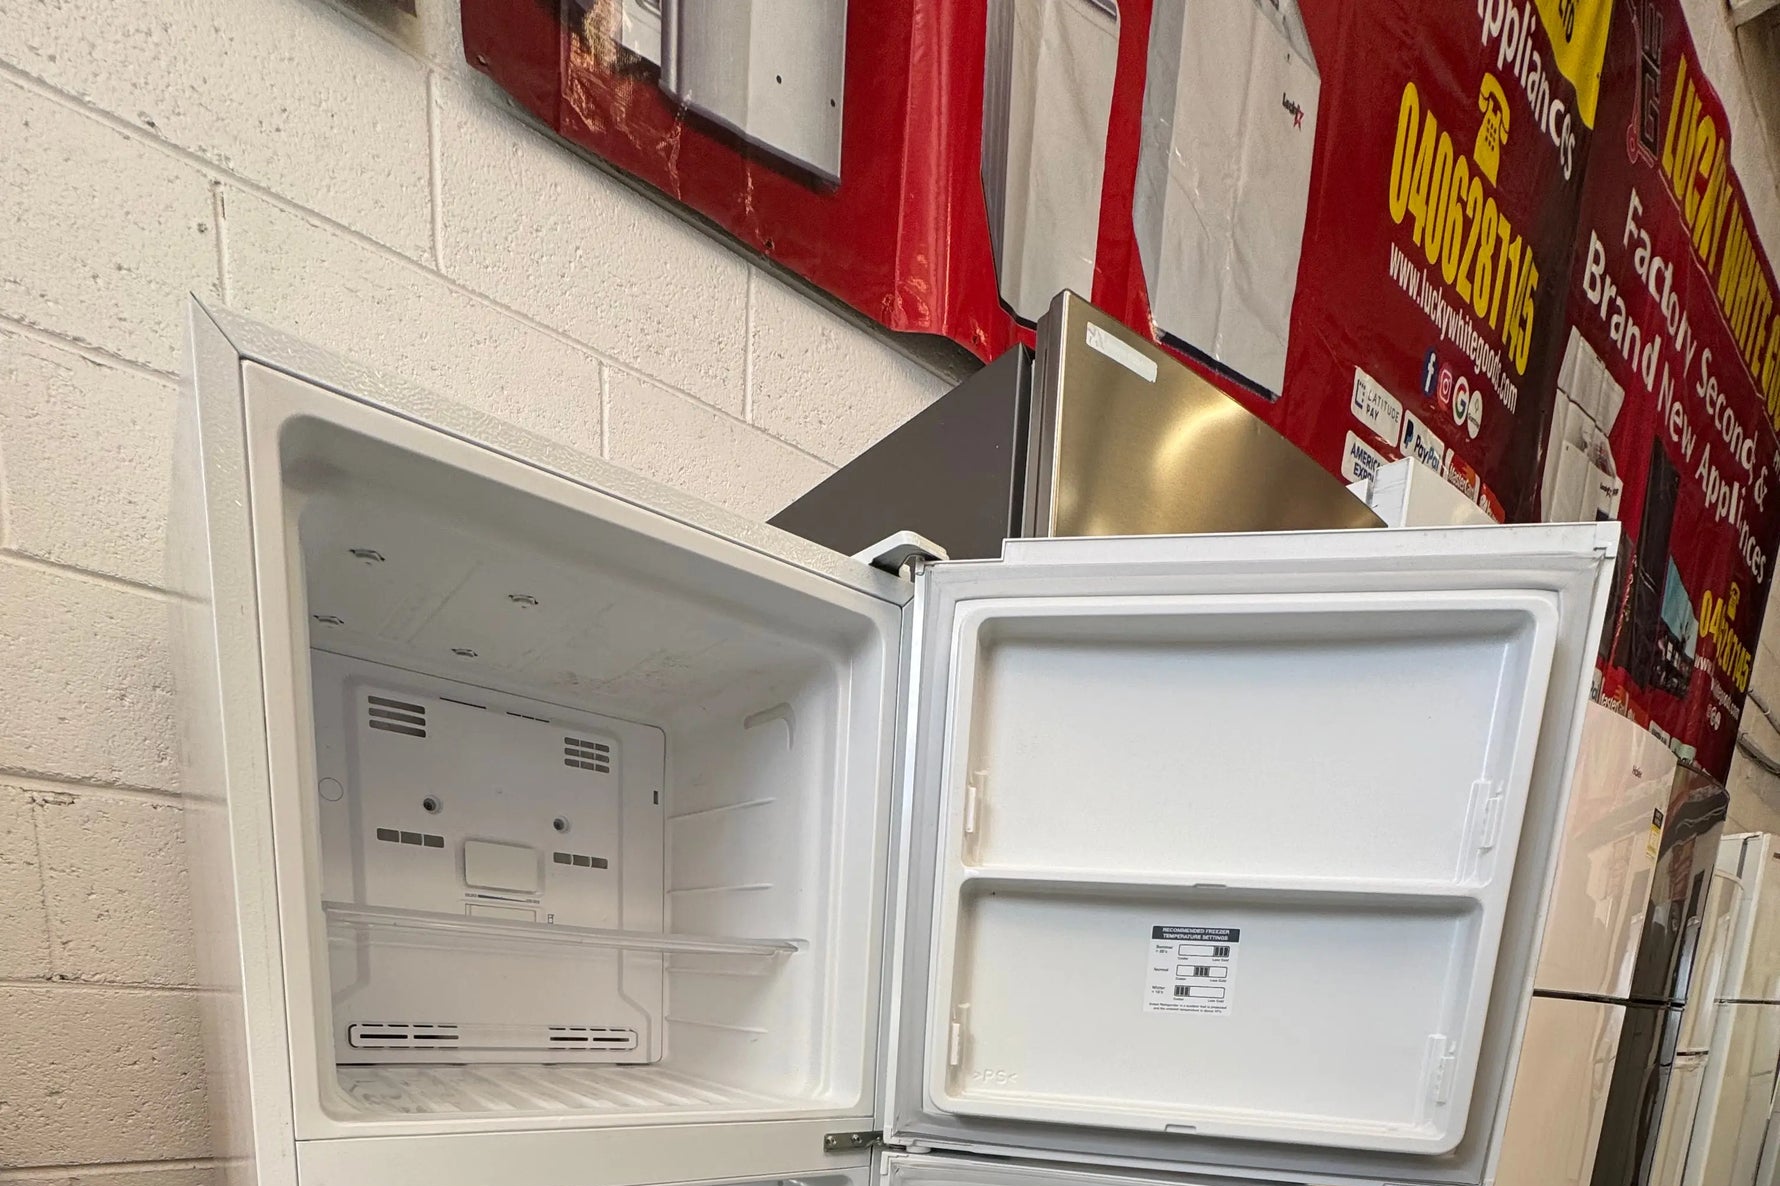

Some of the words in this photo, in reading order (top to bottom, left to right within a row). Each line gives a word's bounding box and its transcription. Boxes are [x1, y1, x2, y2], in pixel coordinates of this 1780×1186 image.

[1478, 0, 1576, 181] ppliances
[1661, 52, 1734, 275] LUCKY
[1389, 81, 1539, 376] 0406287145
[1366, 406, 1380, 422] PAY
[1368, 387, 1400, 424] LATITUDE
[1582, 228, 1662, 393] Brand
[1657, 360, 1697, 464] New
[1623, 187, 1697, 379] Factory
[1754, 465, 1768, 512] &
[1413, 434, 1440, 472] PayPal
